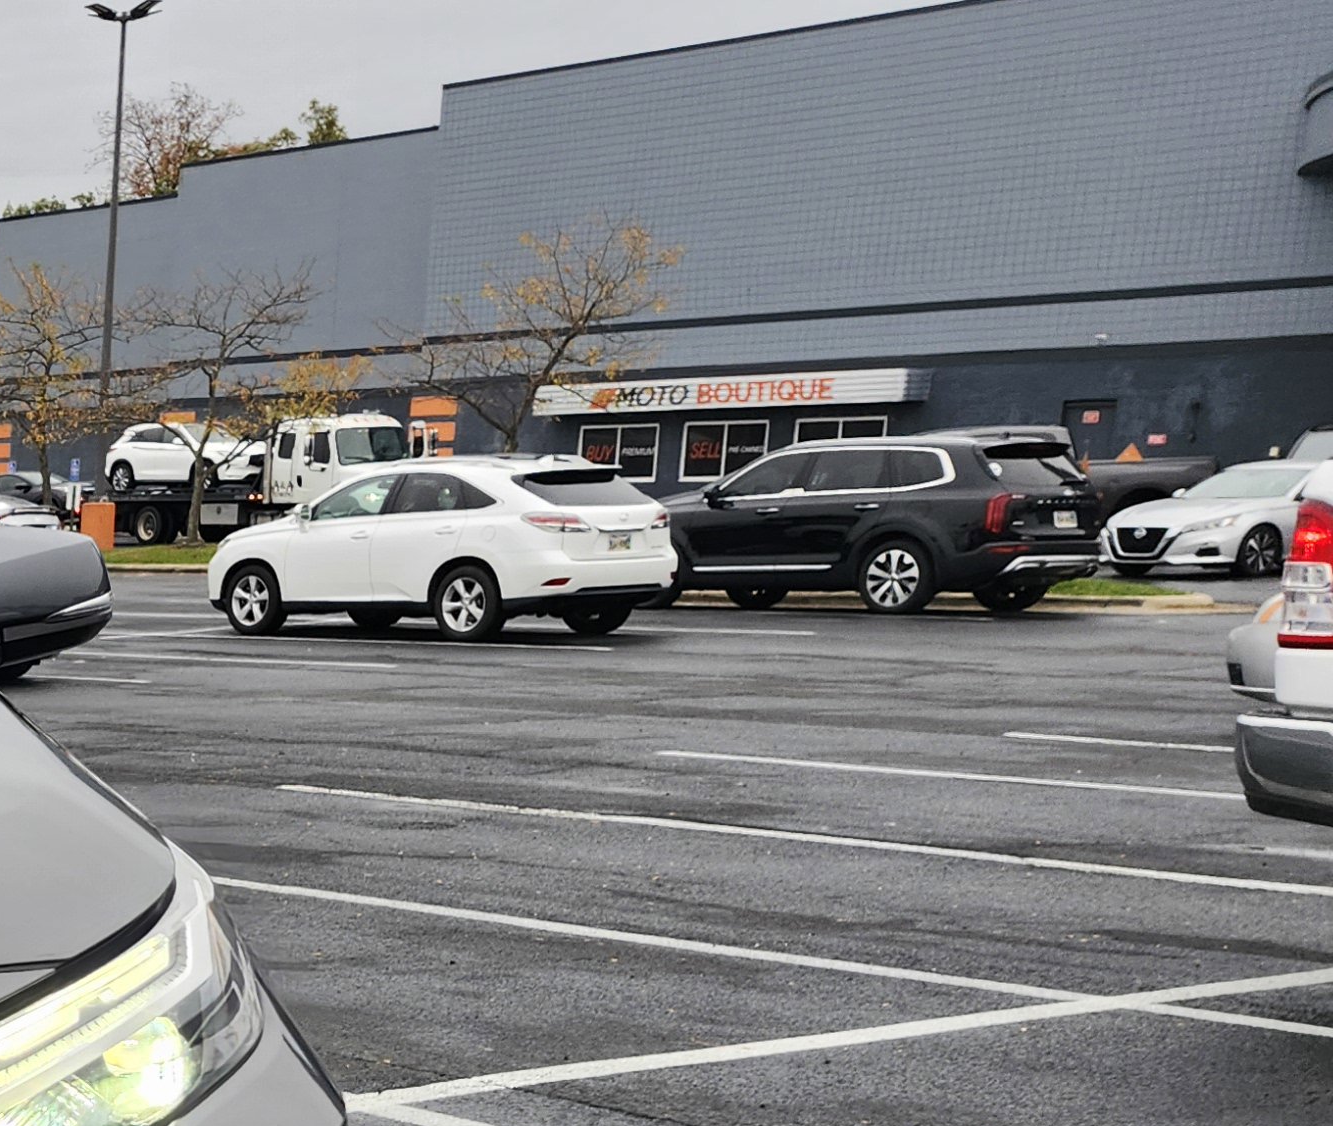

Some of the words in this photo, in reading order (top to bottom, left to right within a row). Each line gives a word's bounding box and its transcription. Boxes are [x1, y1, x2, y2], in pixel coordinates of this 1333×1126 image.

[615, 385, 689, 407] MOTO
[697, 379, 835, 405] BOUTIQUE
[586, 445, 614, 461] BUY
[690, 441, 721, 459] SELL
